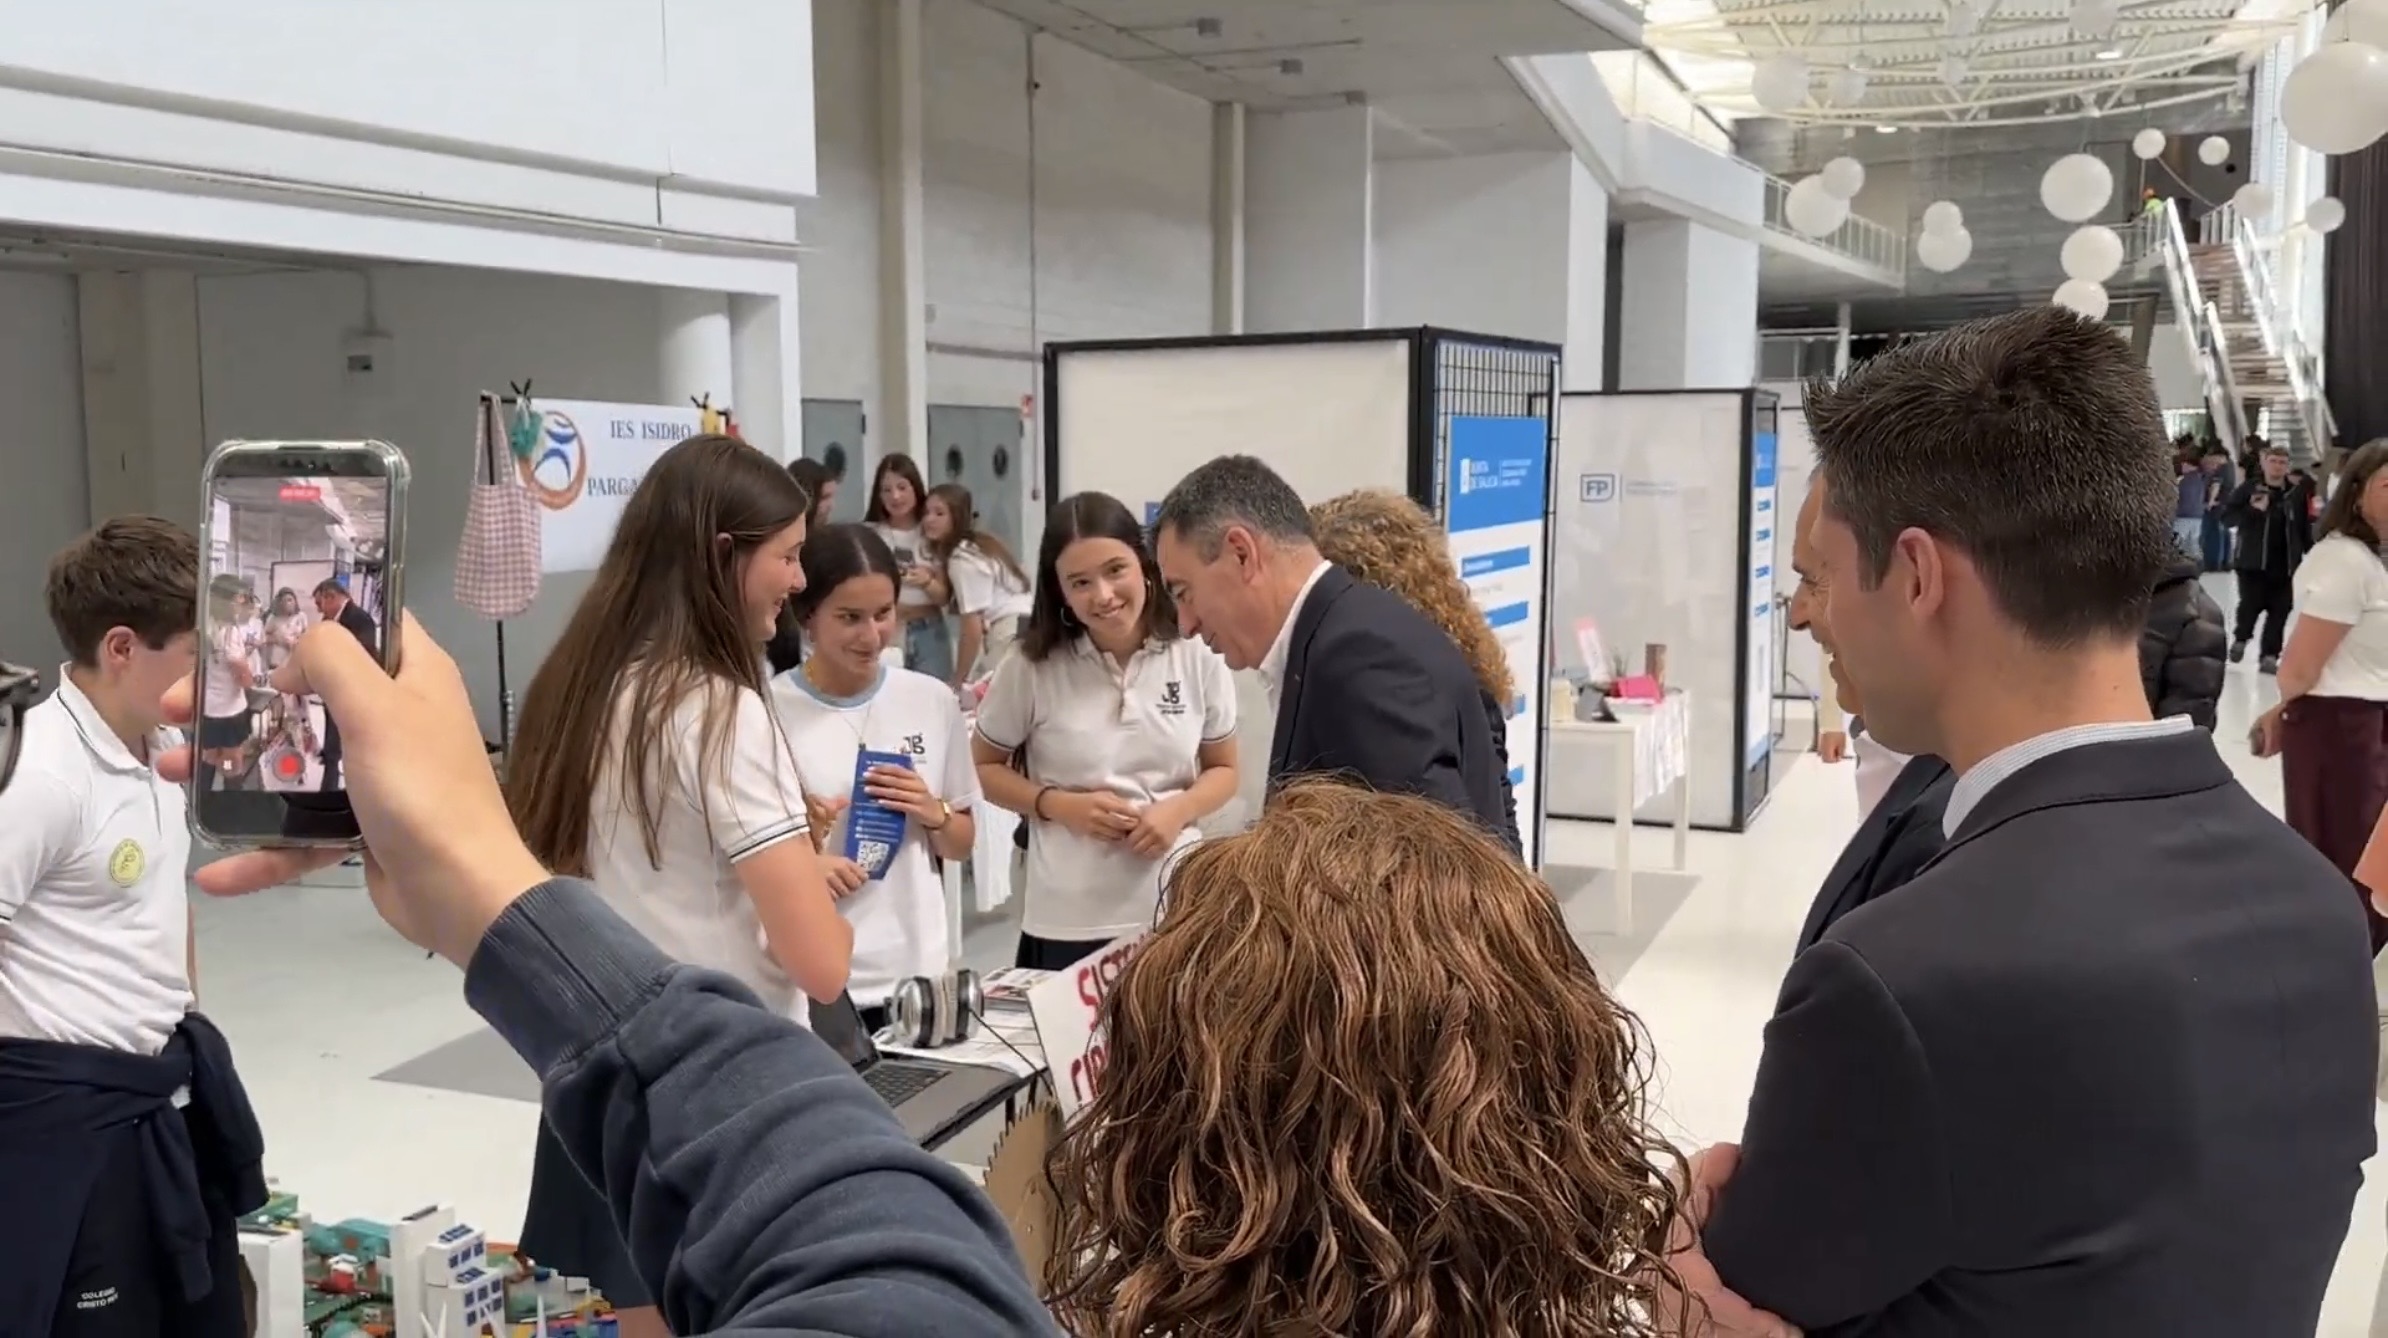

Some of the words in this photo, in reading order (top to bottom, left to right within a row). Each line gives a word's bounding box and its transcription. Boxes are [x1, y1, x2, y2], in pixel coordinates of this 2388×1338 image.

[610, 420, 635, 439] IES
[642, 421, 692, 440] ISIDRO
[1586, 480, 1609, 496] FP
